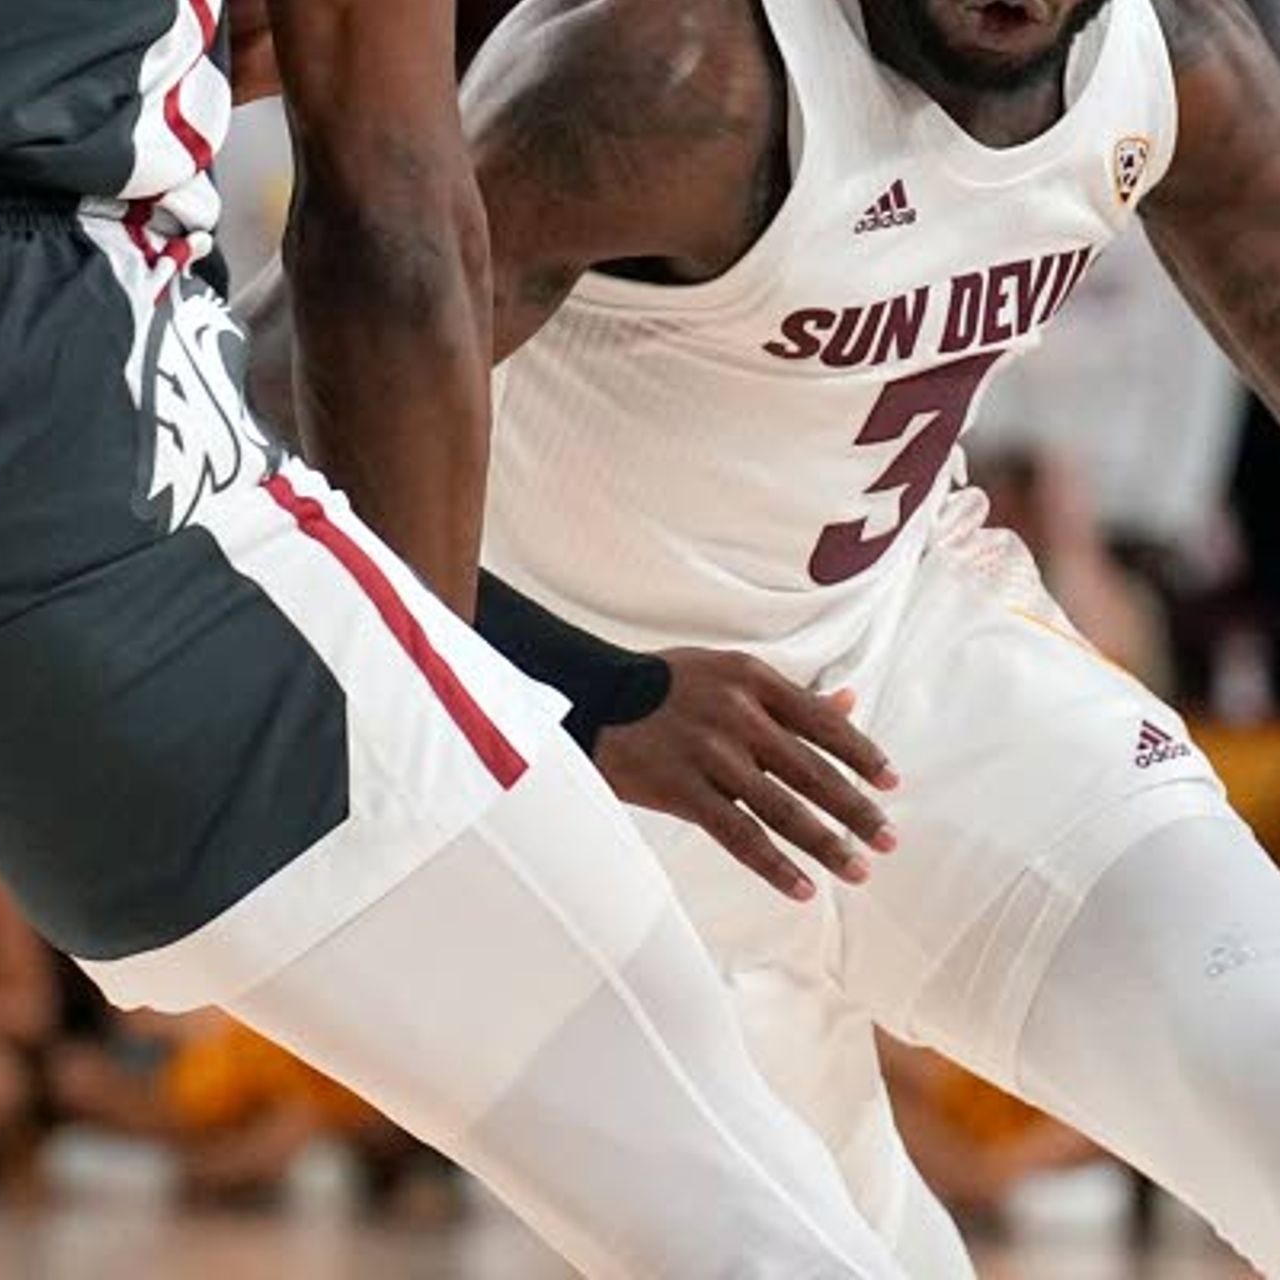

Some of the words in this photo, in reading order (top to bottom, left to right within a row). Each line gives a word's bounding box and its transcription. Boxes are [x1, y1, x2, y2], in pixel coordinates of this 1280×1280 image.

[853, 208, 917, 235] adidas
[762, 286, 931, 368] SUN
[809, 350, 1007, 586] 3
